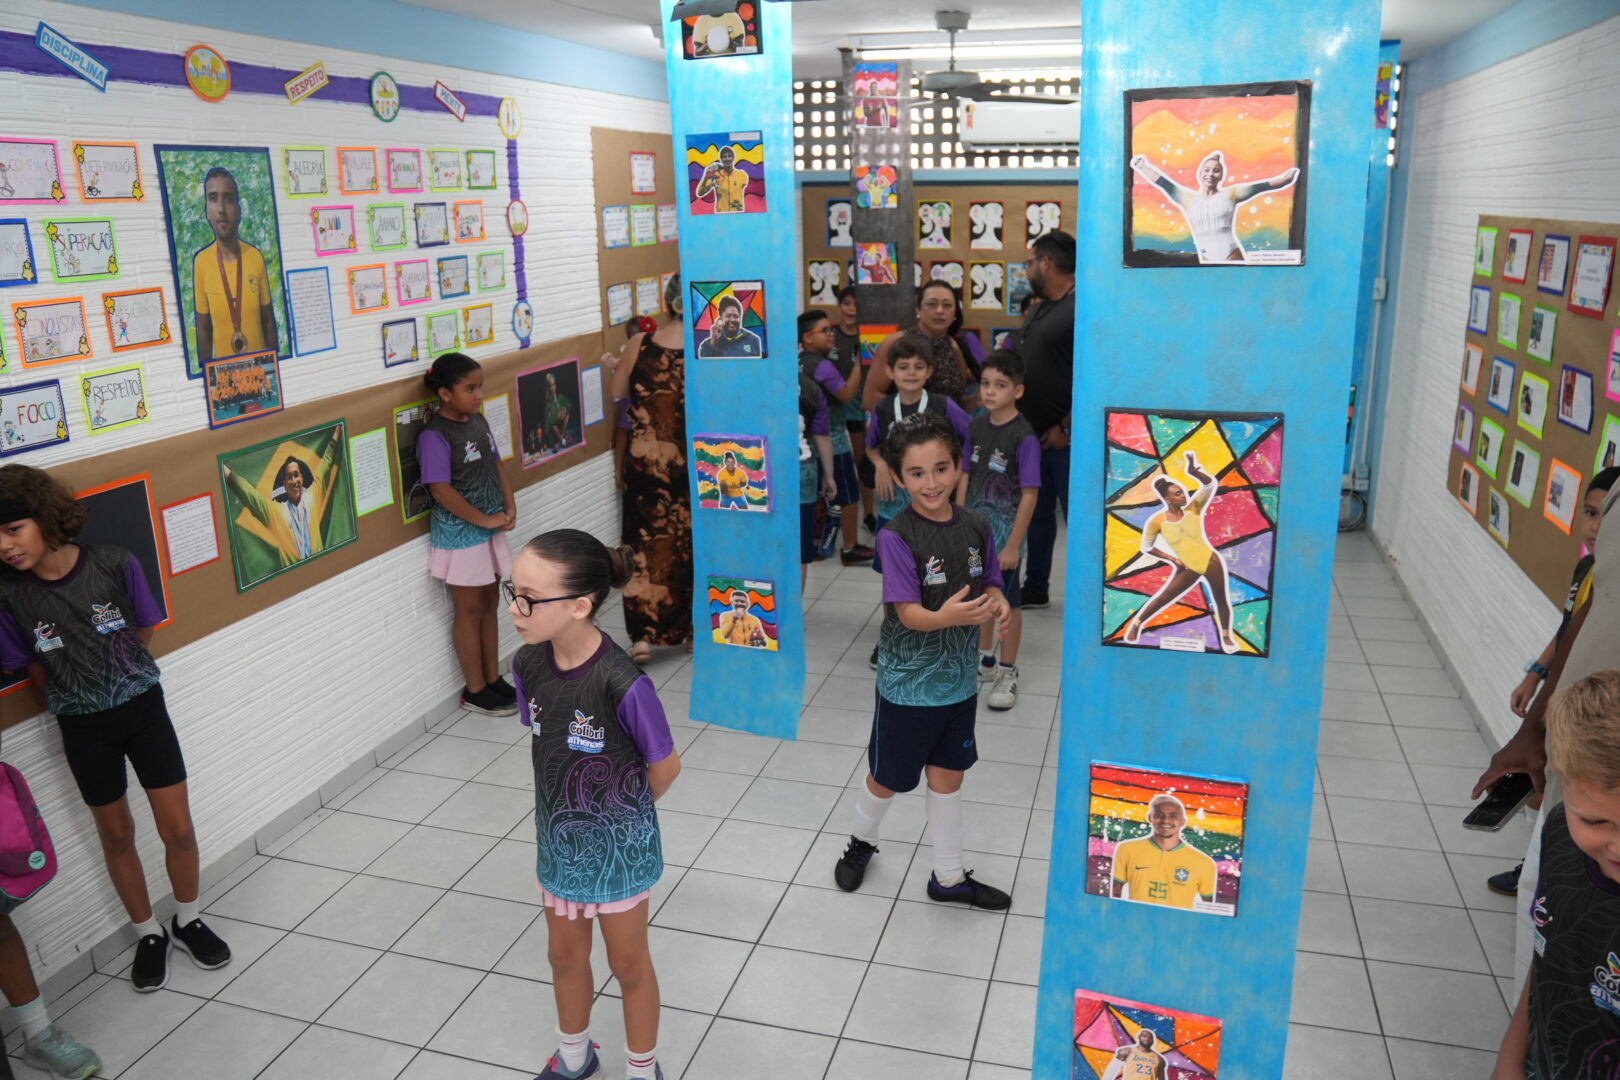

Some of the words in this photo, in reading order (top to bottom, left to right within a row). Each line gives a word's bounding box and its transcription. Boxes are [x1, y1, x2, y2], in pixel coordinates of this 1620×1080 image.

[41, 31, 104, 83] DISCIPLINA
[289, 69, 324, 98] RESPEITO
[92, 378, 140, 403] RESPEITO
[16, 401, 56, 425] FOCO
[569, 721, 604, 740] Colibri
[1148, 881, 1167, 898] 25
[1136, 1063, 1153, 1076] 23
